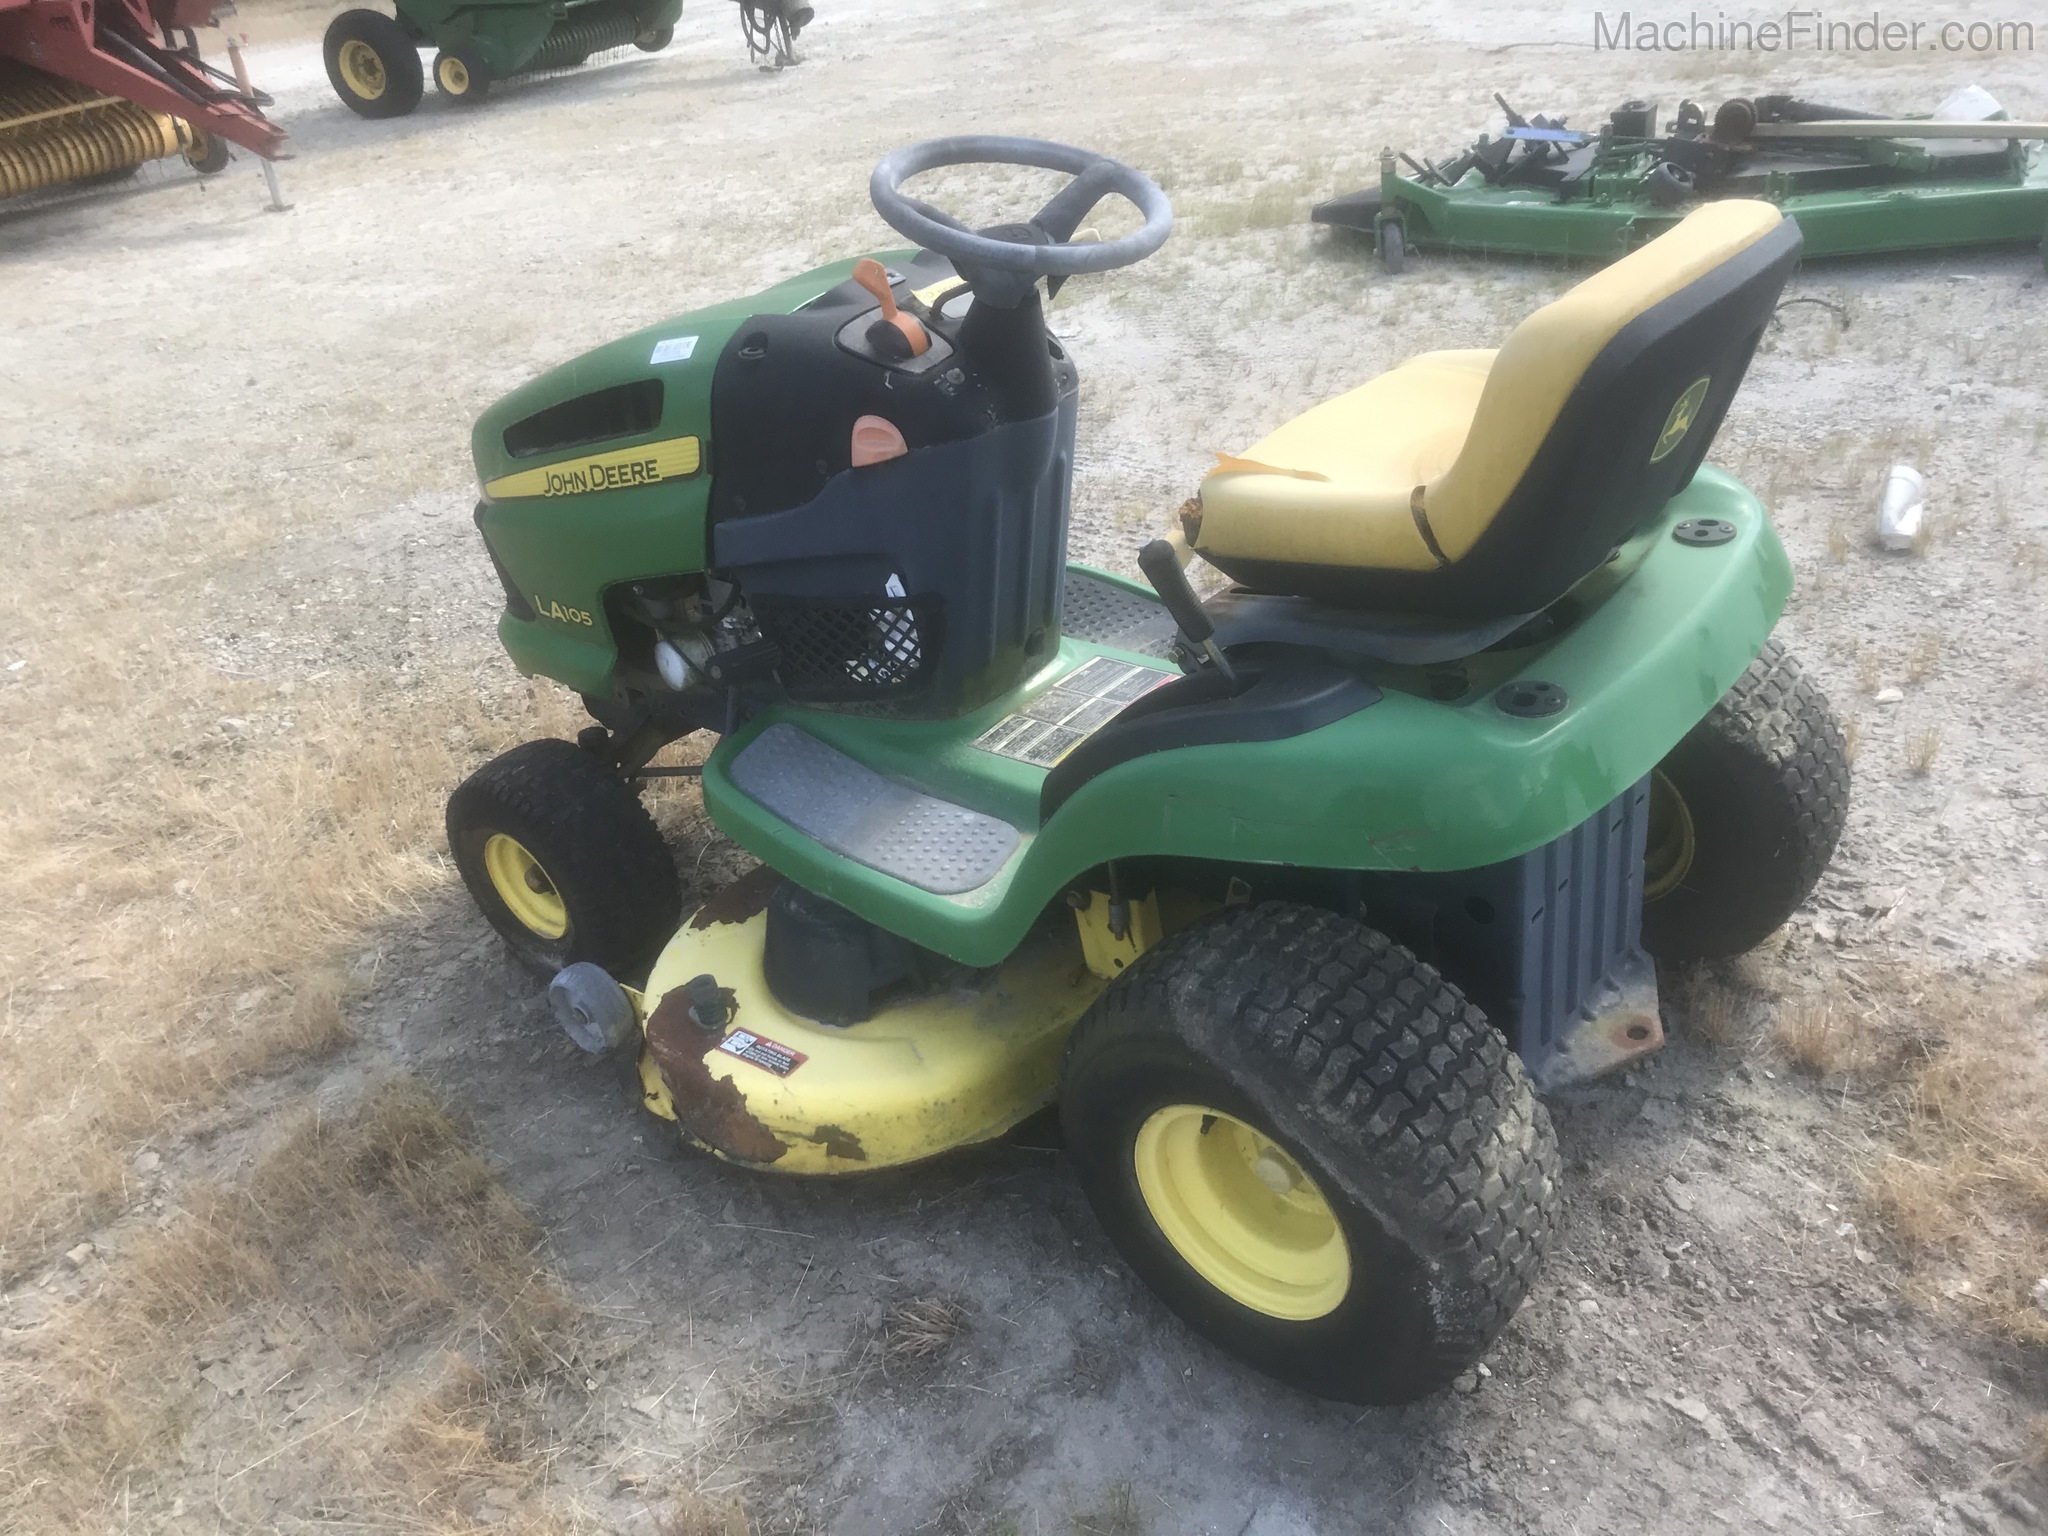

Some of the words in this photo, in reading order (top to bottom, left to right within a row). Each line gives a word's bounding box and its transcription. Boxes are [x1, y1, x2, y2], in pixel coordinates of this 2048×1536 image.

[544, 470, 588, 494] JOHN
[589, 459, 660, 488] DEERE
[534, 594, 593, 627] LA105
[771, 1043, 796, 1057] DANGER
